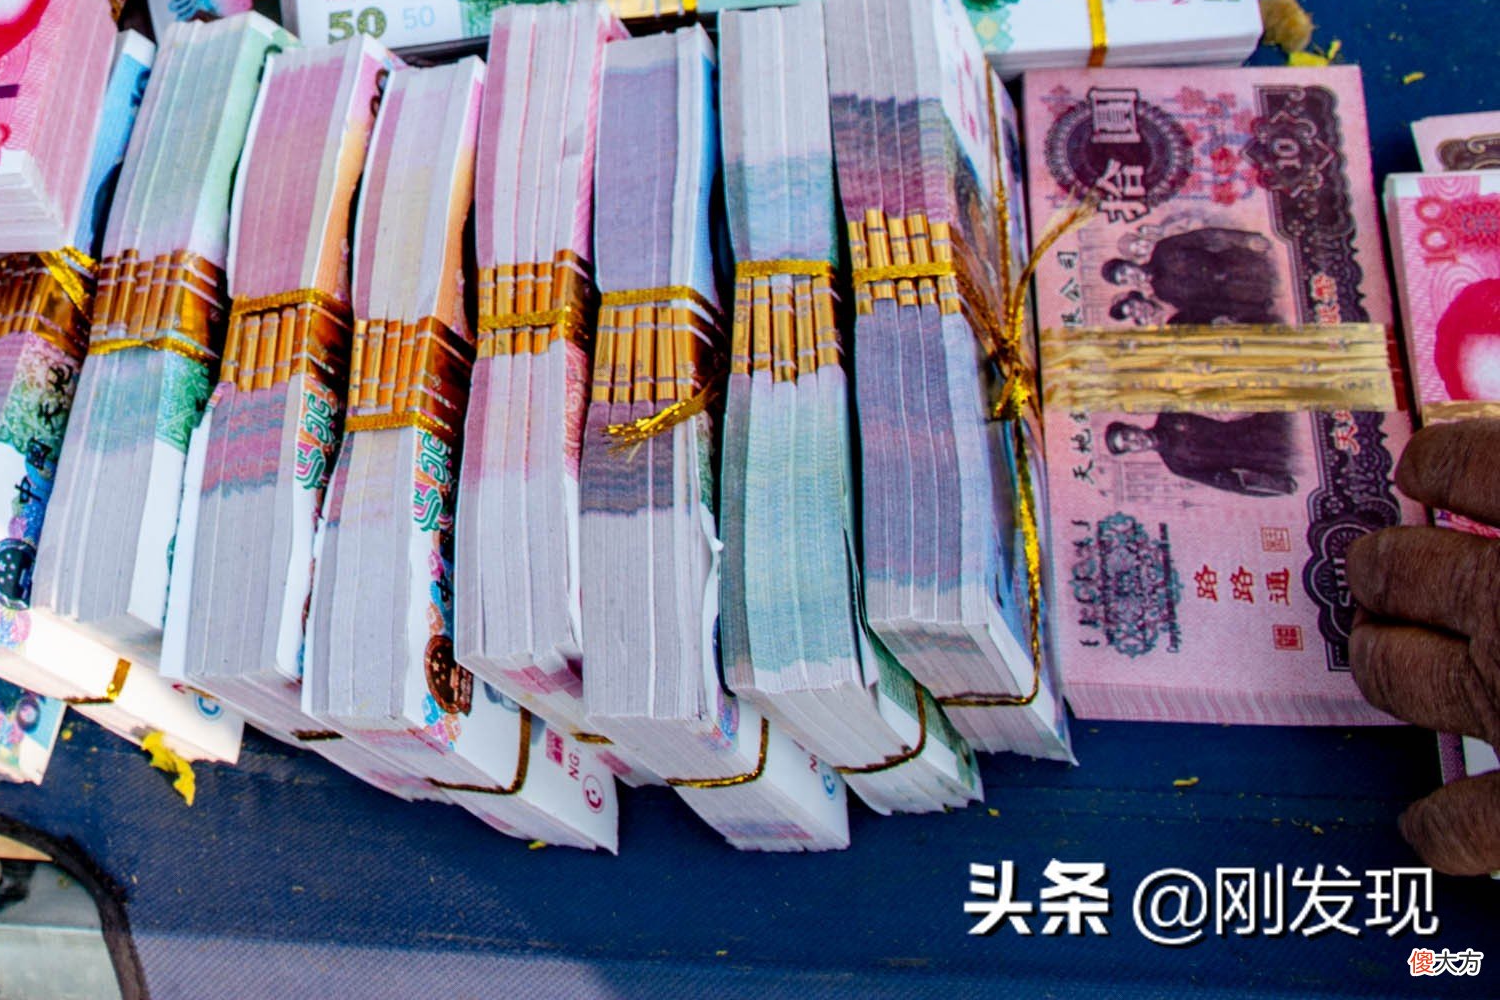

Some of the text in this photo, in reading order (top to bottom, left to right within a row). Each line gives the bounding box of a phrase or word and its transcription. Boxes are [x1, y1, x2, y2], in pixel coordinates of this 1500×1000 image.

[328, 5, 436, 45] 50 50
[1274, 140, 1301, 172] 10
[1414, 197, 1456, 266] 100
